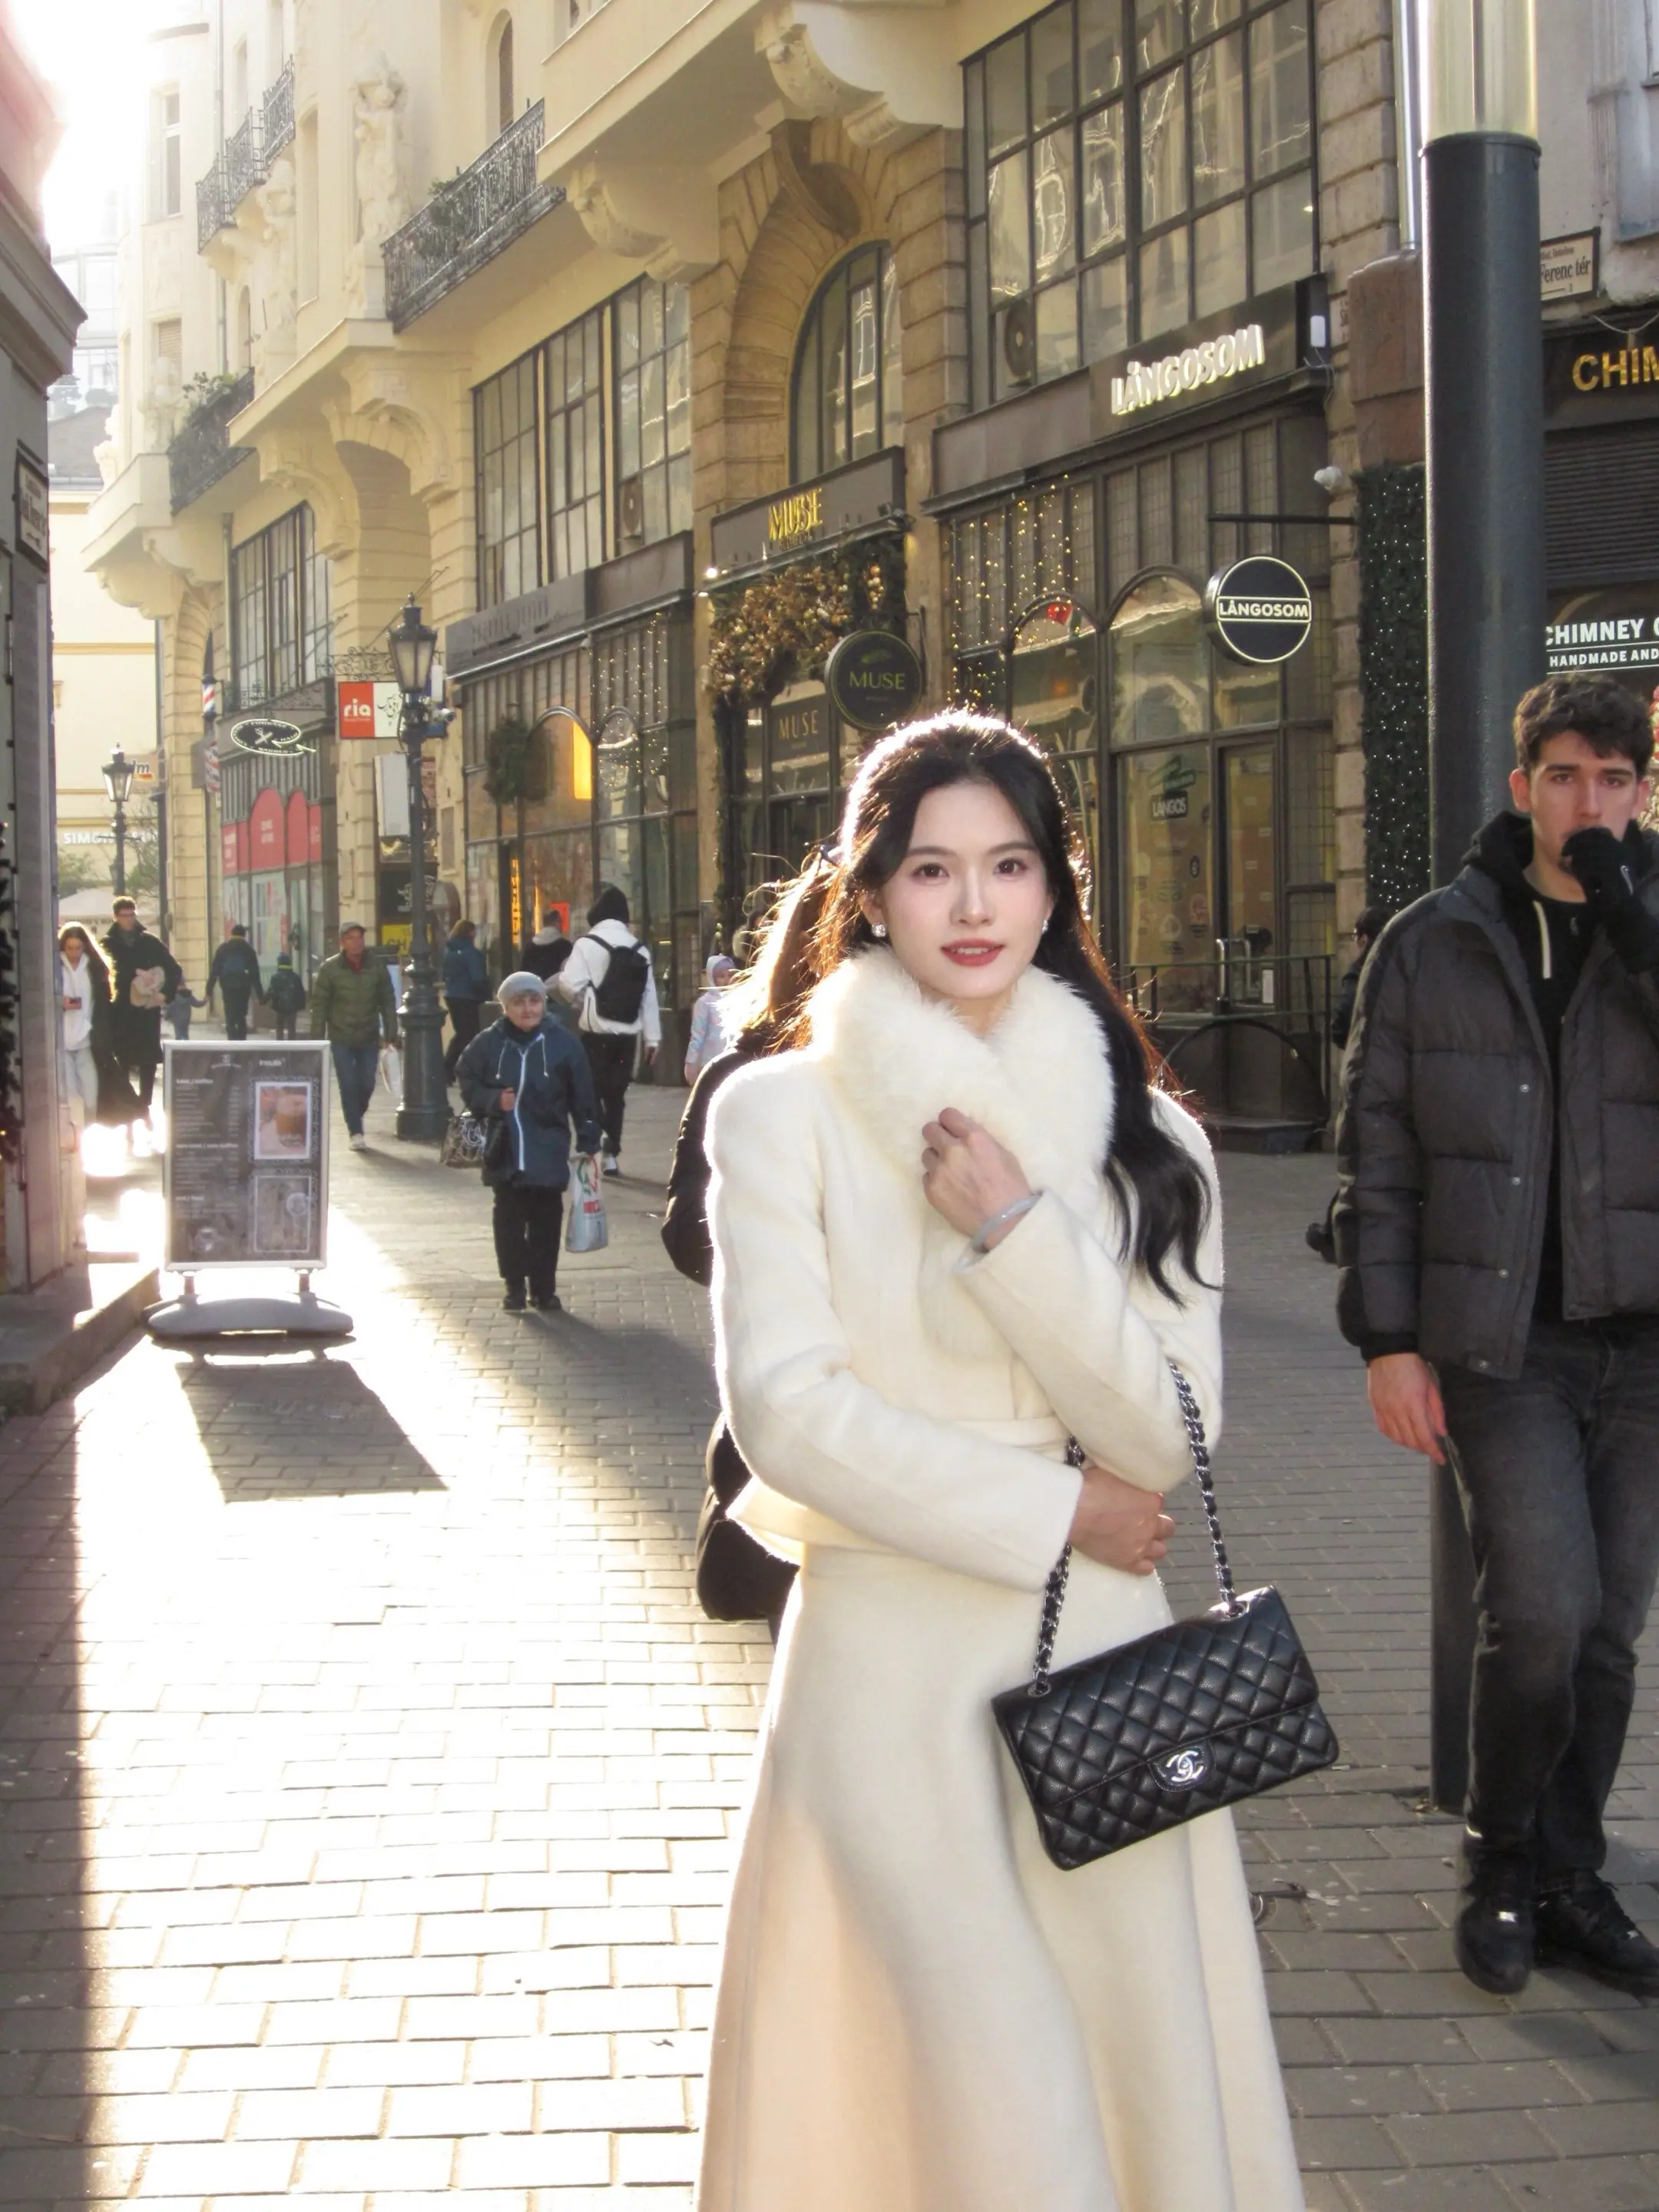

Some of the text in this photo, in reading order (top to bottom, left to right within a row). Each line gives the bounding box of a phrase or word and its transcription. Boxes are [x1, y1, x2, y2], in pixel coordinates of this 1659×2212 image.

[1575, 255, 1591, 276] tér
[770, 488, 823, 541] MUSE
[1549, 648, 1659, 667] HANDMADE AND
[849, 671, 906, 690] MUSE
[343, 698, 371, 717] ria
[779, 710, 819, 740] MUSE
